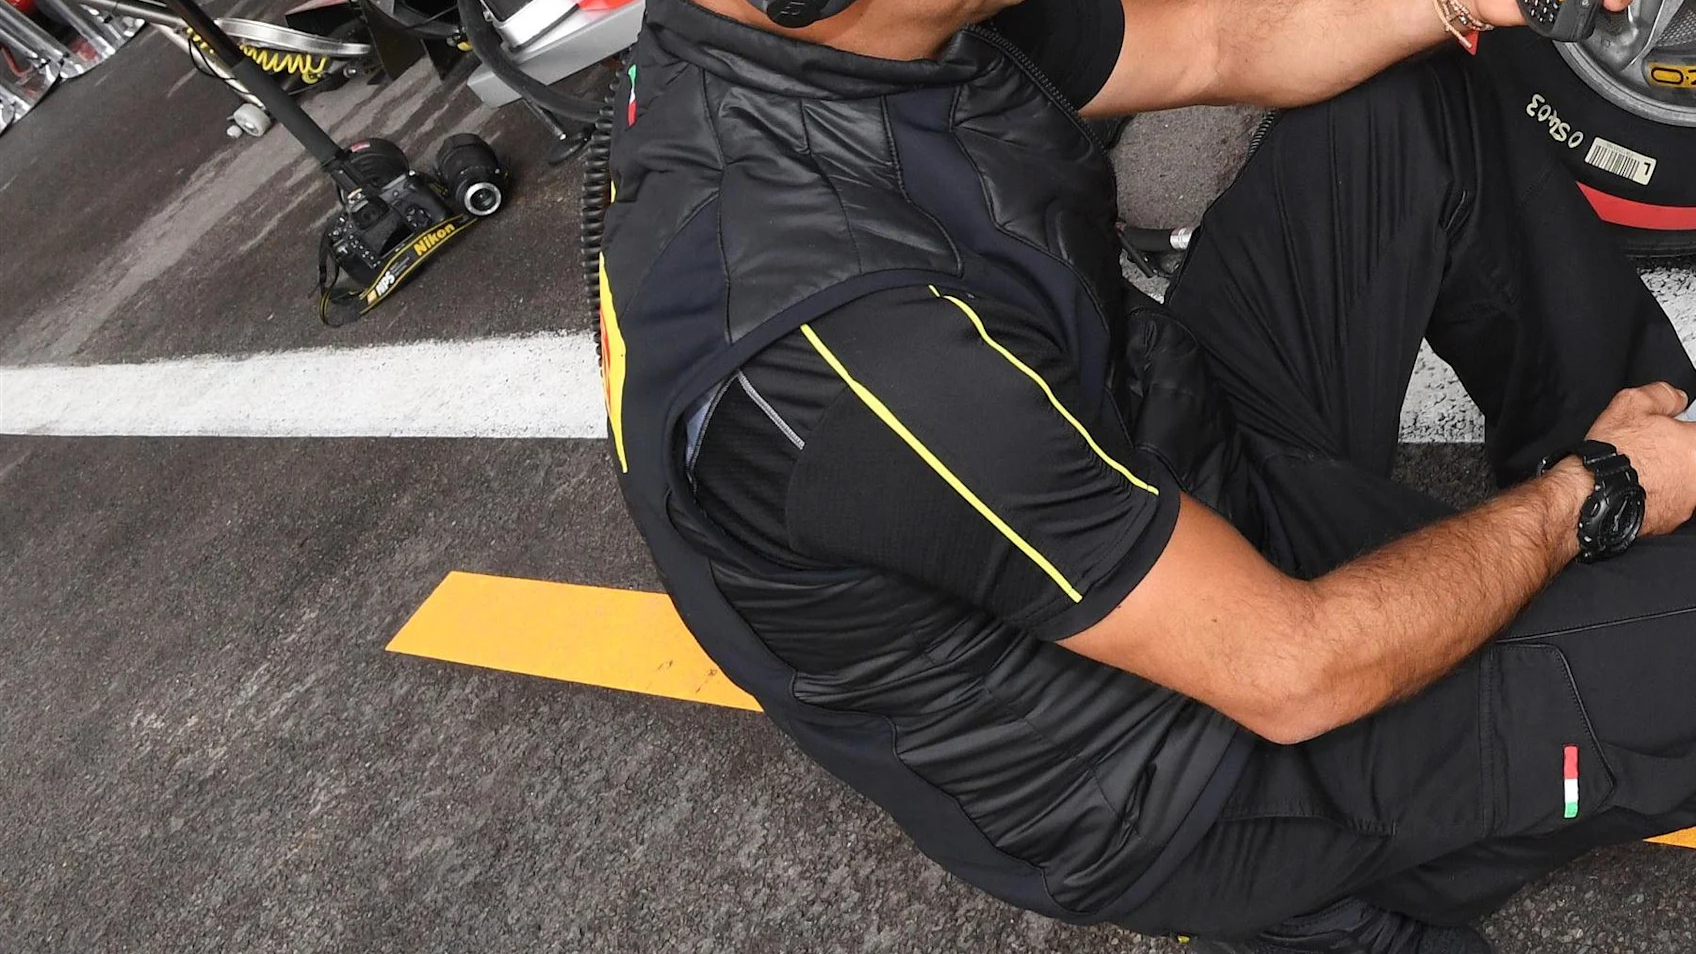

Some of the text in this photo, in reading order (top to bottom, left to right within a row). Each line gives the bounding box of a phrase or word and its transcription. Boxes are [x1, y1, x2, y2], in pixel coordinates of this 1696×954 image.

[1525, 93, 1584, 148] 05403
[1643, 162, 1651, 175] L
[413, 222, 456, 256] Nikon
[376, 270, 395, 296] NPS
